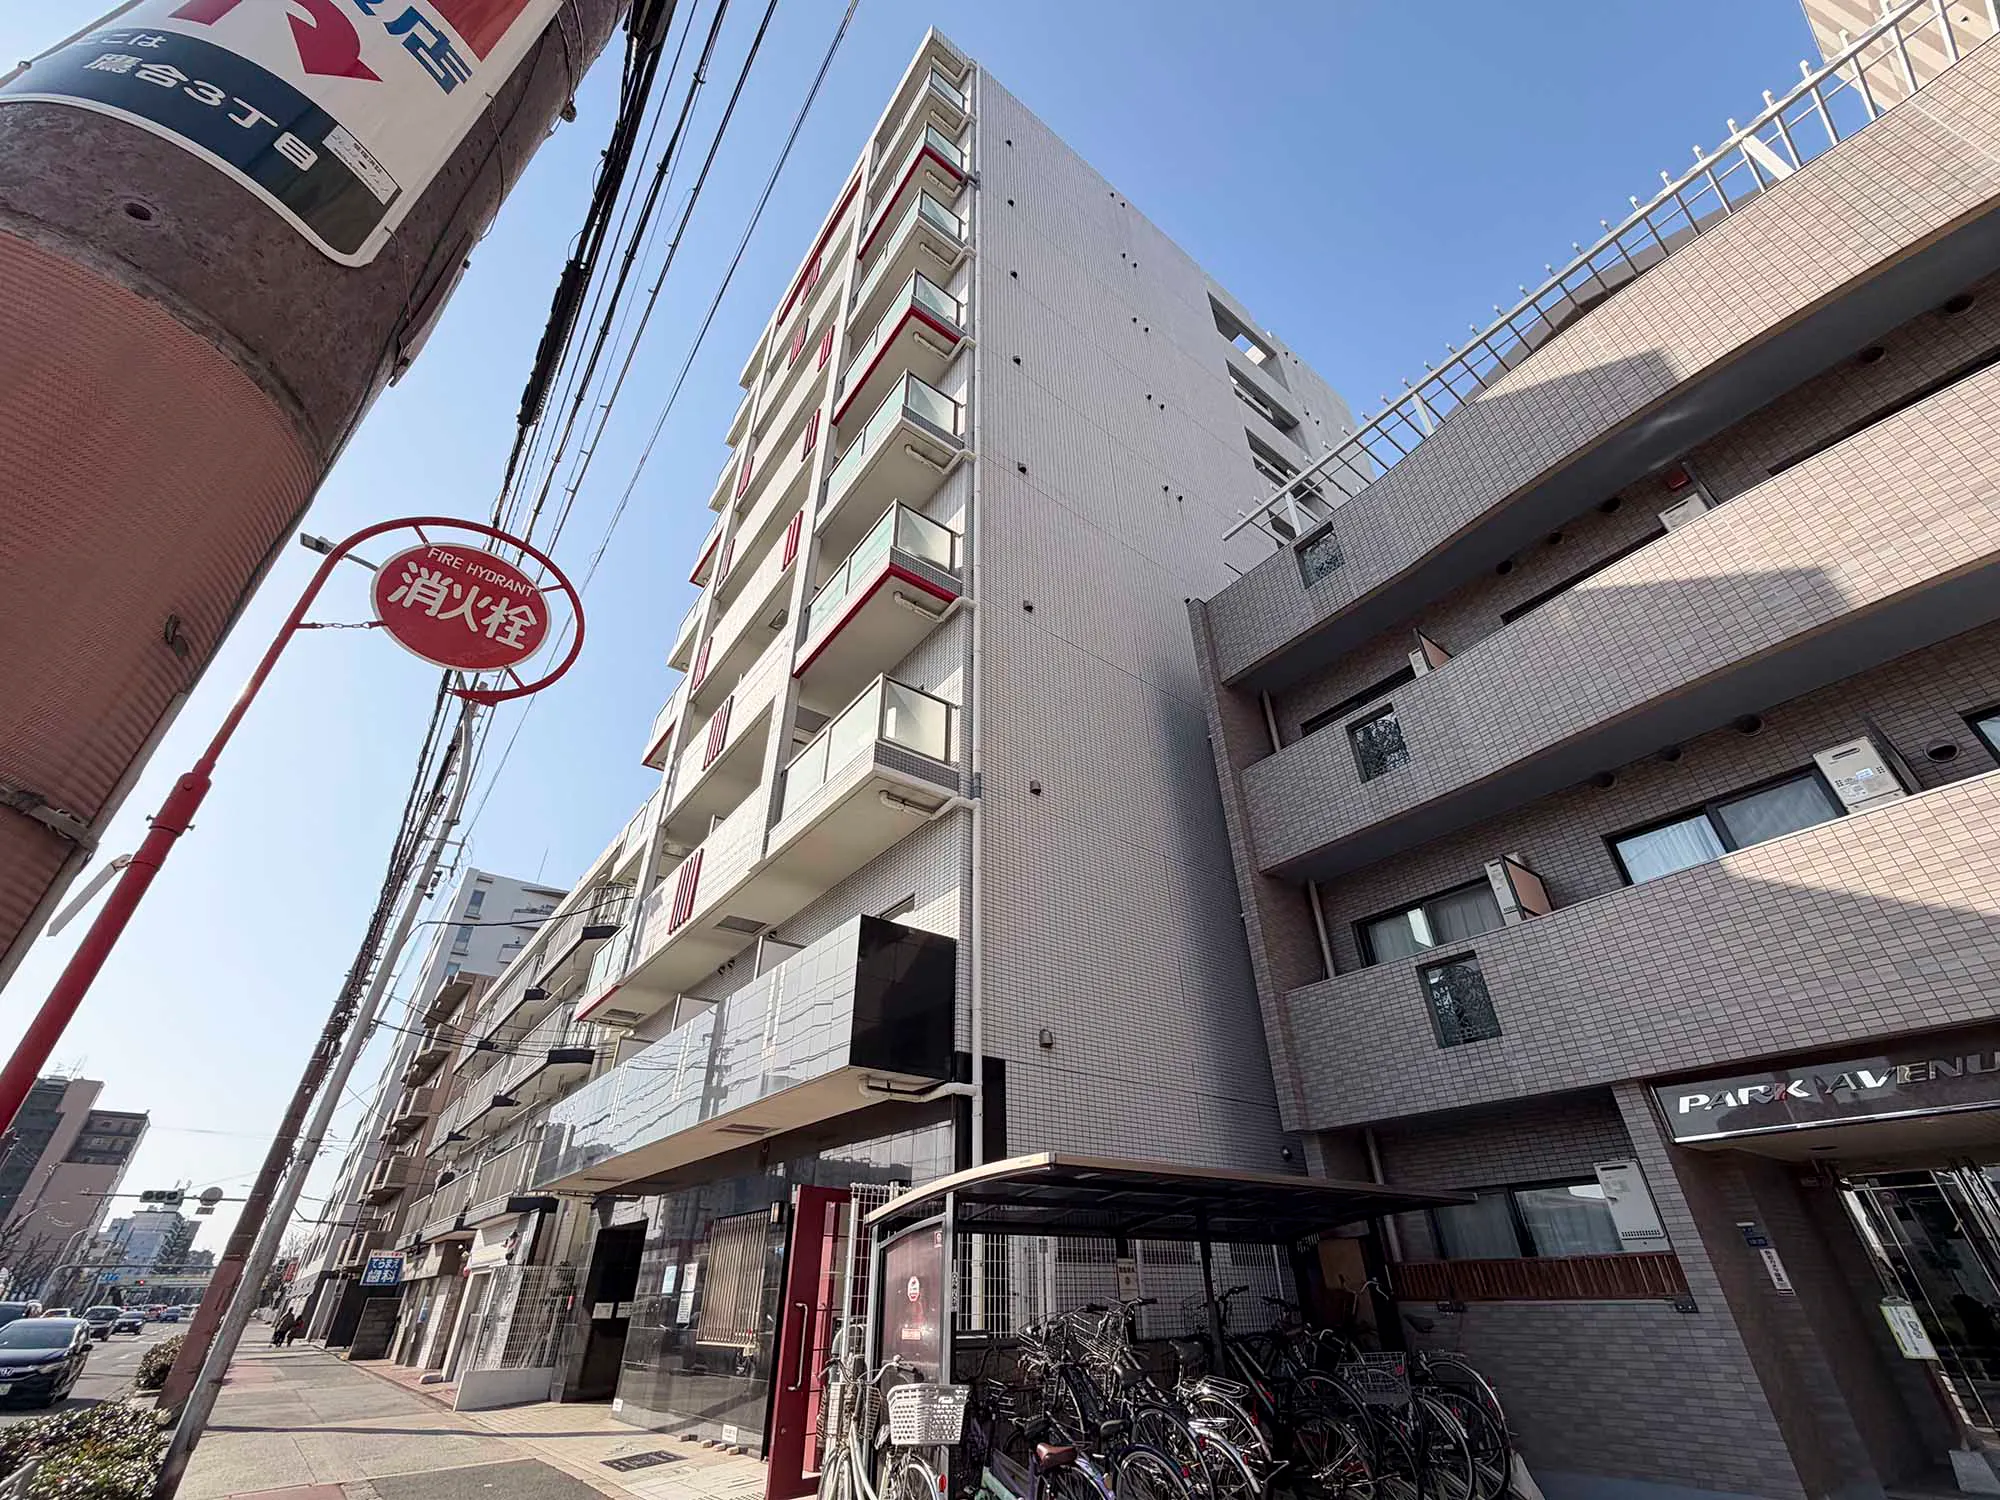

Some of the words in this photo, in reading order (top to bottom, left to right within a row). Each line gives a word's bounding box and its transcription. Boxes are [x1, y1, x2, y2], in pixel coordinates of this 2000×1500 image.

[83, 53, 319, 172] 鷹合3丁目
[427, 547, 465, 570] FIRE
[466, 562, 535, 597] HYDRANT
[387, 561, 538, 650] 消火栓
[1678, 1079, 1811, 1114] PARK
[366, 1270, 396, 1283] 歯科
